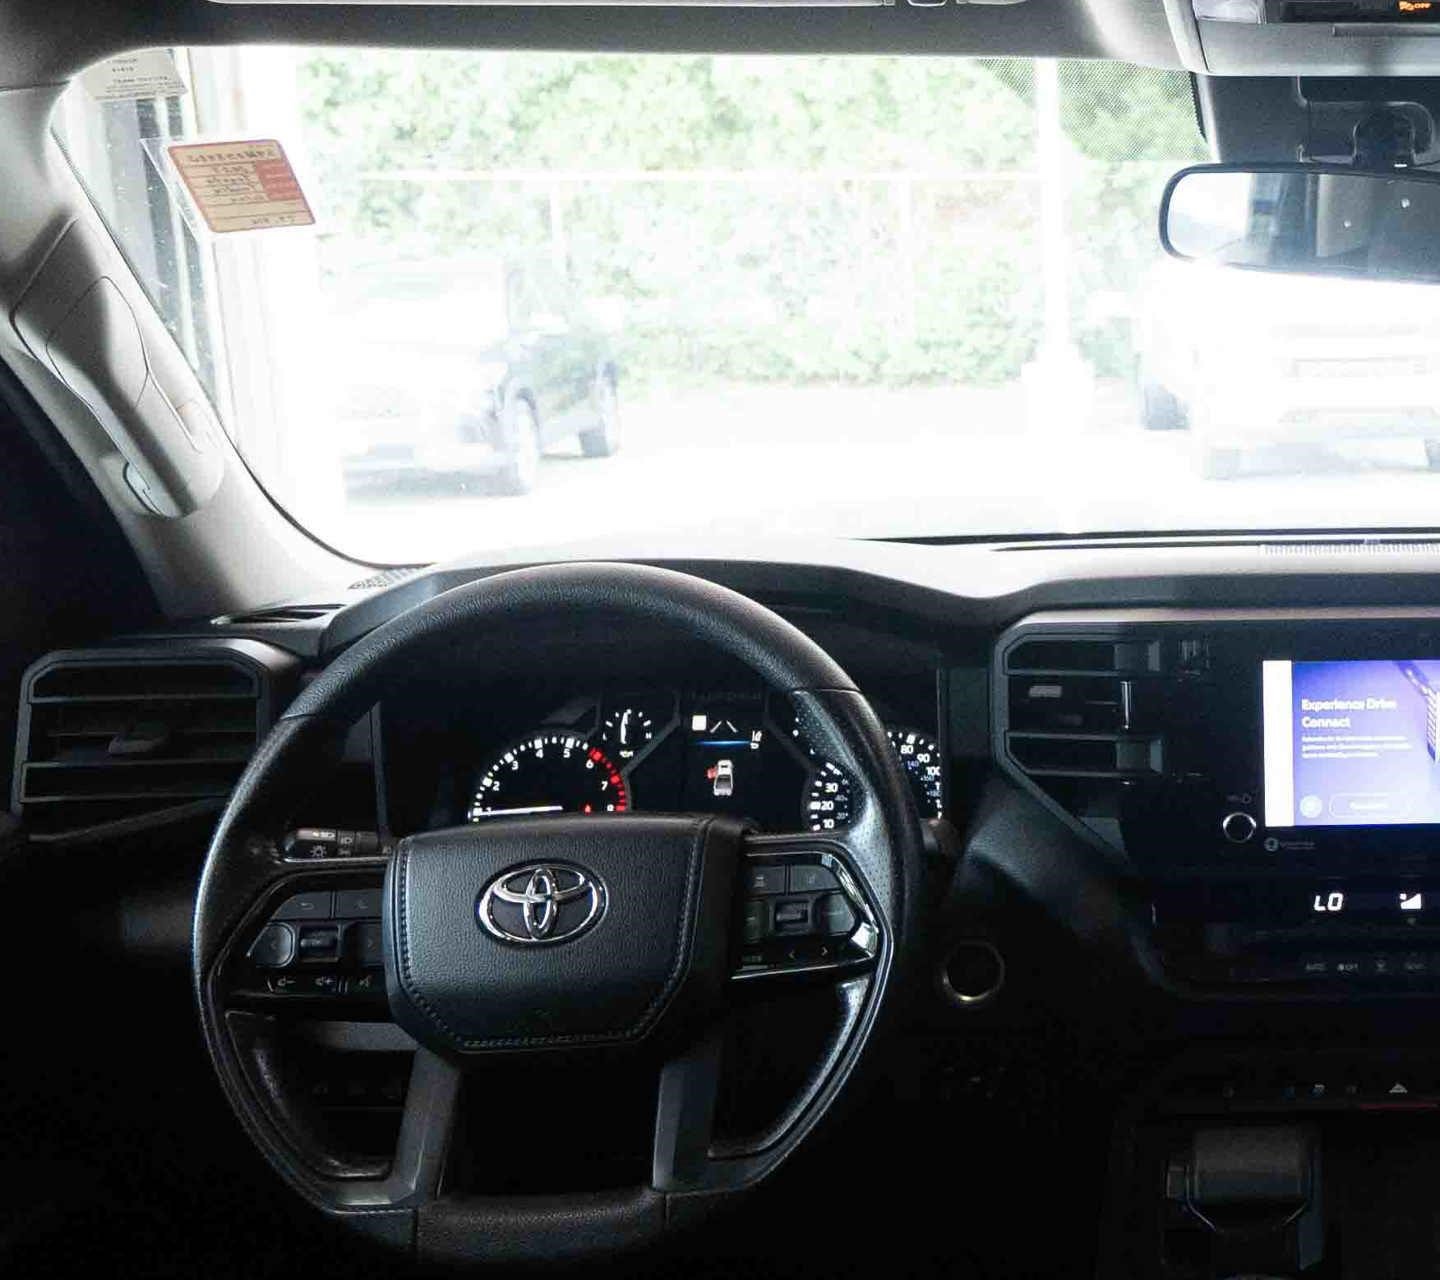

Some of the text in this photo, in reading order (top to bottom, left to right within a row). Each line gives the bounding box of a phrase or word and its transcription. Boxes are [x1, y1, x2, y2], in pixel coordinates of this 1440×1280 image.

[1301, 716, 1352, 728] Connect
[535, 749, 544, 758] 4
[563, 749, 571, 758] 5
[900, 744, 914, 754] 80
[916, 753, 930, 763] 90
[511, 761, 518, 770] 3
[586, 759, 594, 769] 6
[492, 781, 500, 791] 2
[601, 780, 608, 790] 7
[825, 782, 838, 793] 30
[820, 800, 834, 810] 20
[822, 818, 835, 829] 10
[1313, 892, 1344, 911] LO
